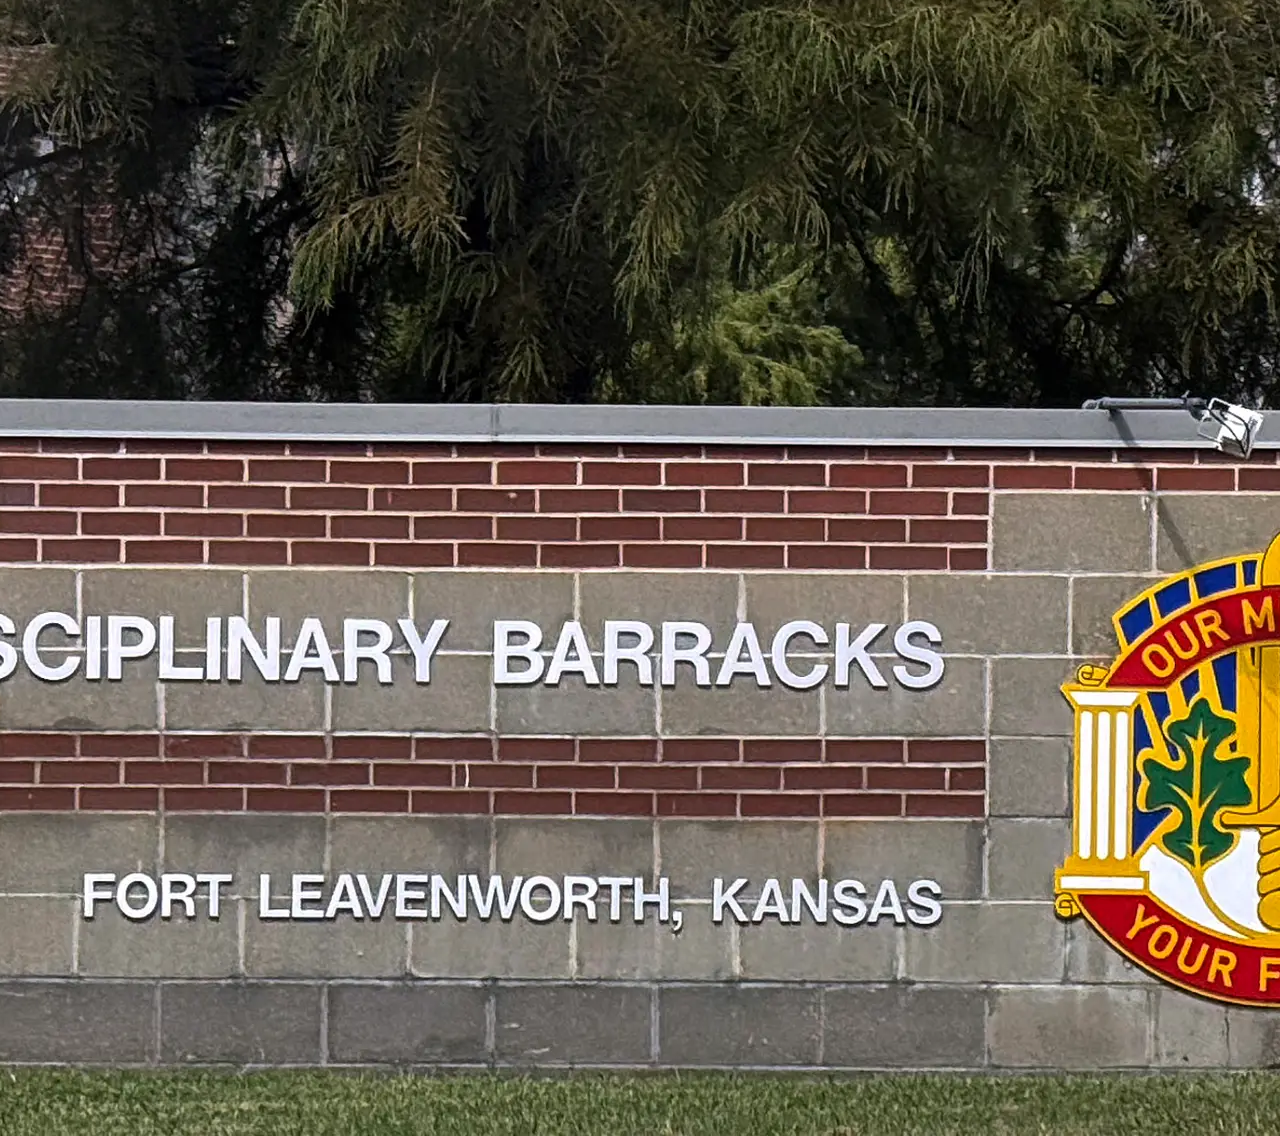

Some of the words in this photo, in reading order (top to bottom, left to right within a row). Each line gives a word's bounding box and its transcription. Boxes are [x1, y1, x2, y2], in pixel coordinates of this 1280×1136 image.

[492, 619, 946, 690] BARRACKS
[1141, 607, 1230, 680] OUR
[82, 871, 233, 921] FORT
[258, 872, 683, 933] LEAVENWORTH,
[712, 877, 944, 926] KANSAS
[1125, 903, 1238, 989] YOUR
